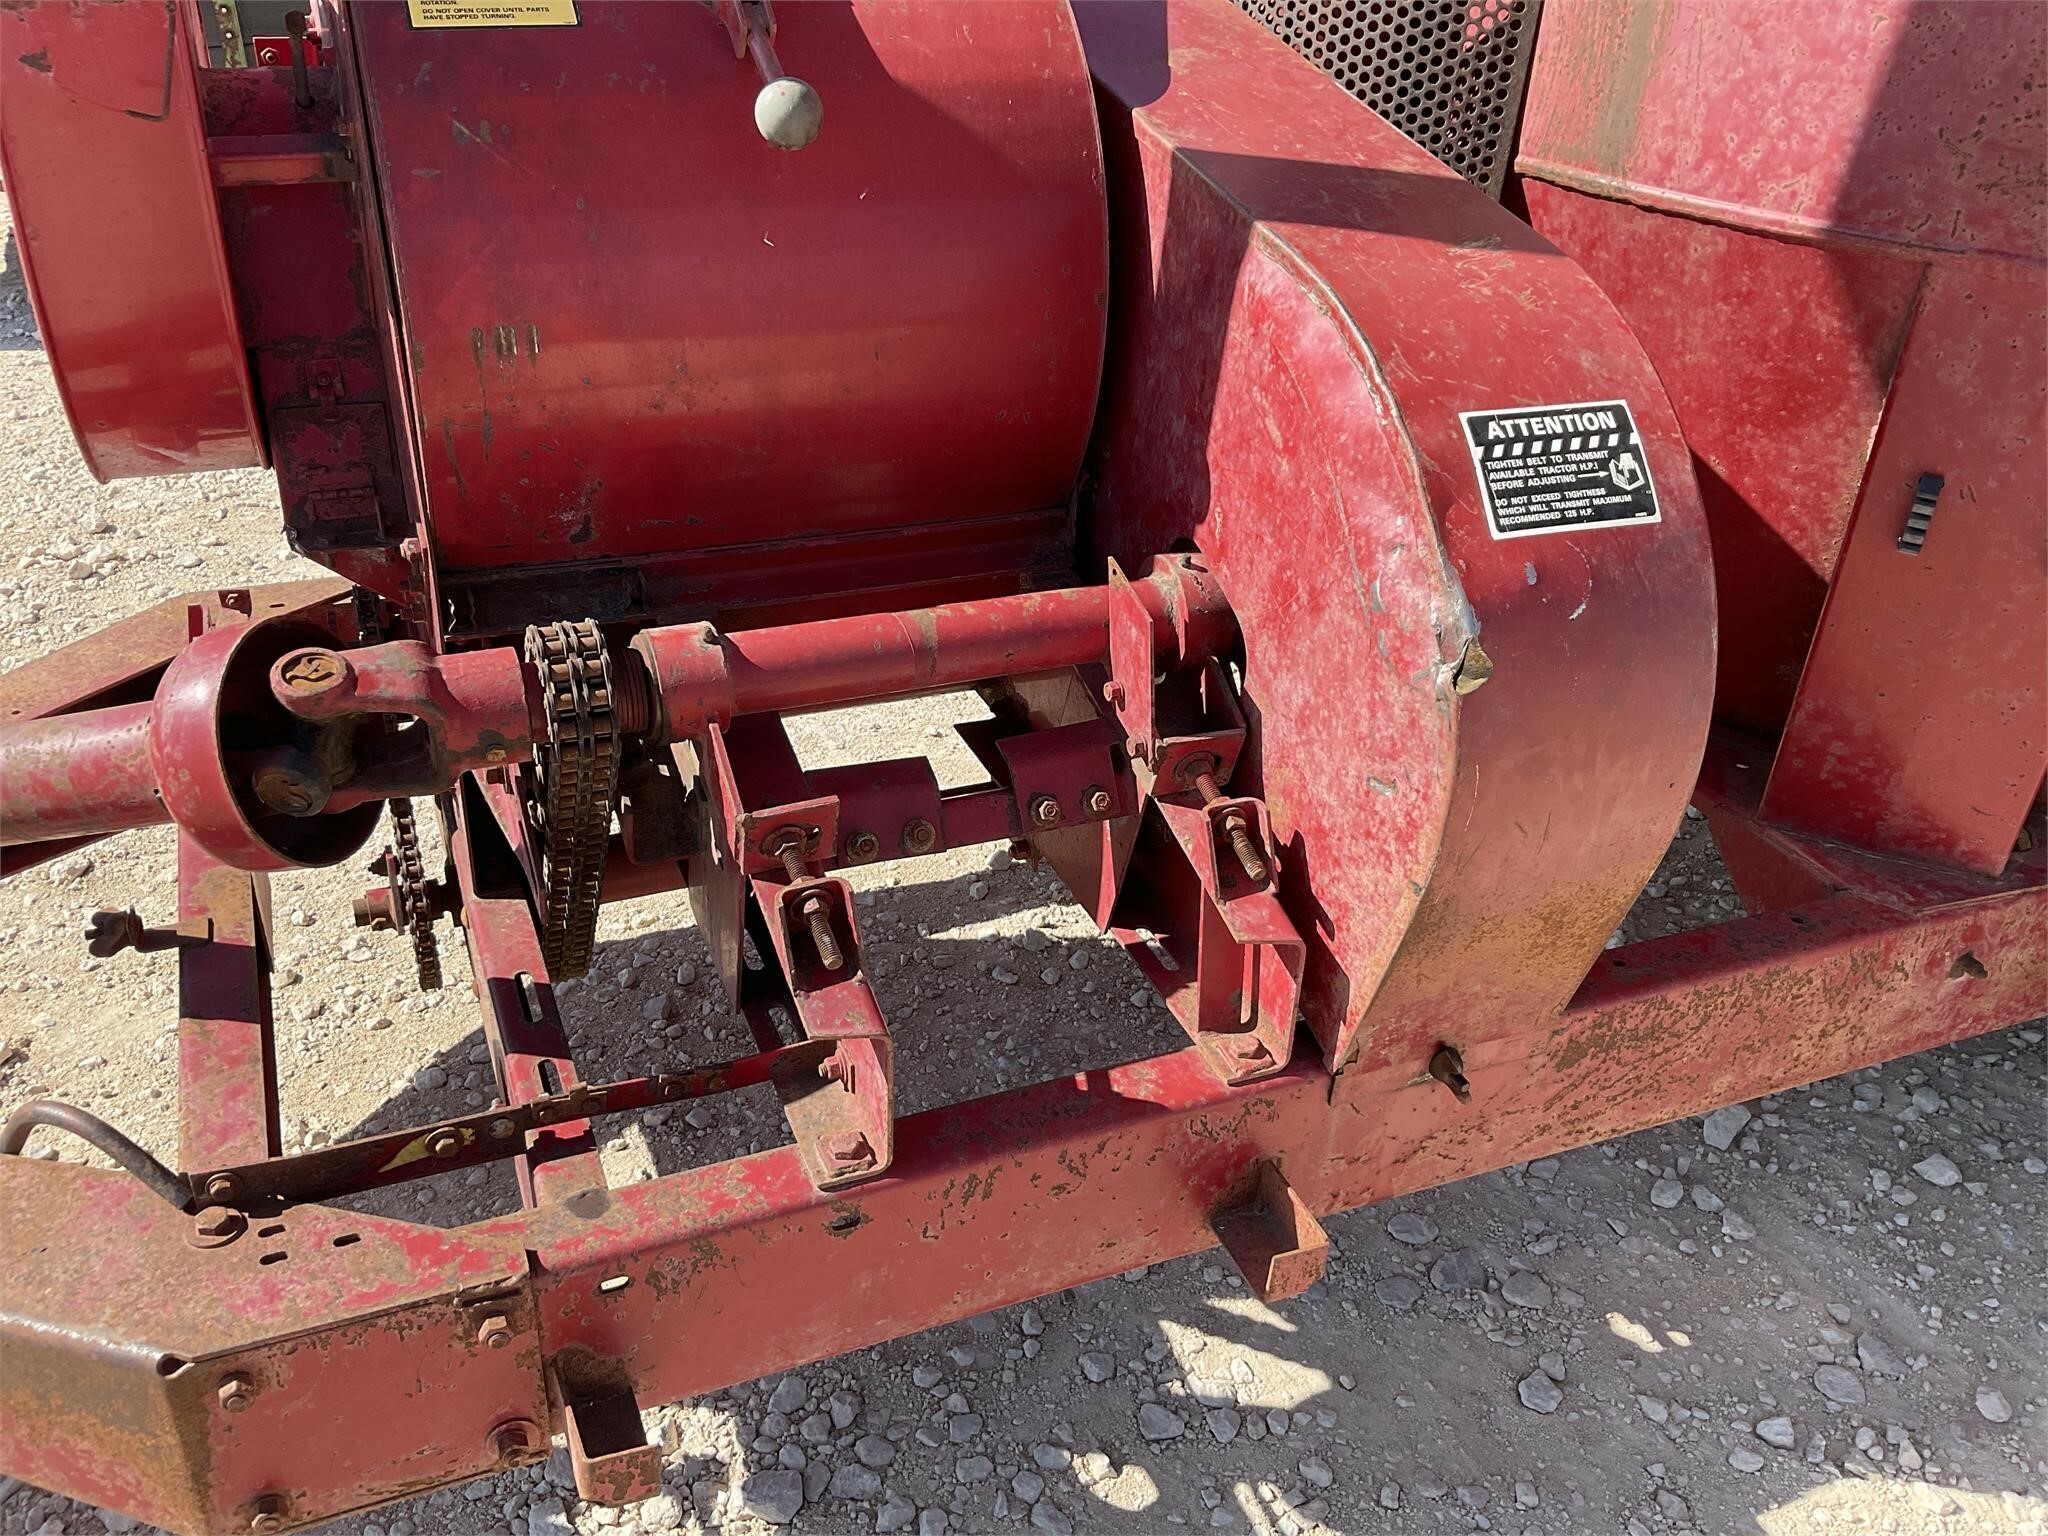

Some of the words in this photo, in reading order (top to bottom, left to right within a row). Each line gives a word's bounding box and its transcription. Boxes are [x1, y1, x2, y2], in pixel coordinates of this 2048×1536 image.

[1487, 411, 1617, 440] ATTENTION
[1485, 459, 1524, 470] TIGHTEN
[1526, 456, 1547, 466] BELT
[1550, 455, 1563, 463] TO
[1565, 450, 1609, 462] TRANSMIT
[1489, 468, 1535, 480] AVAILABLE
[1537, 463, 1578, 475] TRACTOR
[1490, 480, 1525, 491] BEFORE
[1528, 474, 1577, 487] ADJUSTING
[1495, 498, 1508, 507] DO
[1511, 496, 1528, 505] NOT
[1531, 492, 1561, 503] EXCEED
[1563, 487, 1607, 499] TIGHTNESS
[1497, 506, 1526, 516] WHICH
[1528, 504, 1549, 513] WILL
[1550, 499, 1590, 510] TRANSMIT
[1592, 494, 1632, 505] MAXIMUM
[1499, 511, 1562, 526] RECOMMENDED
[1563, 509, 1577, 518] 125
[1579, 508, 1595, 517] H.P.
